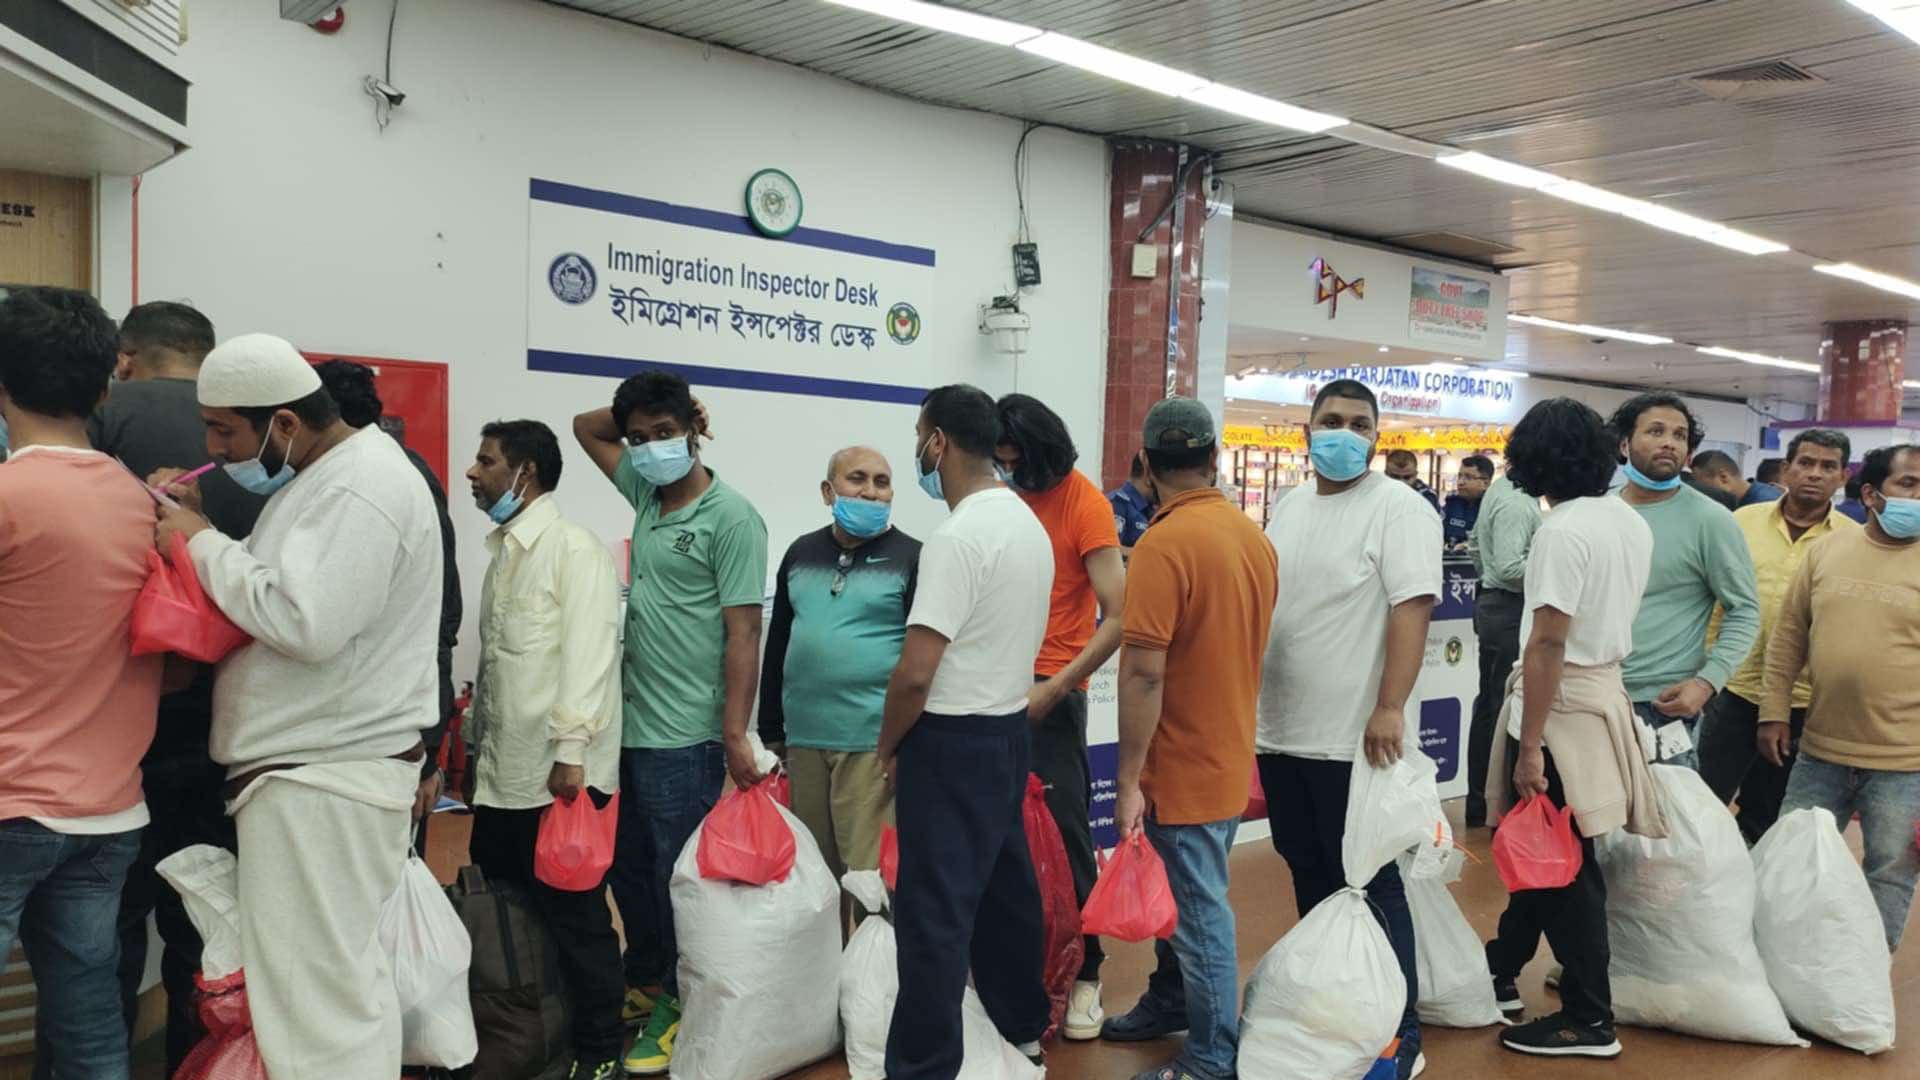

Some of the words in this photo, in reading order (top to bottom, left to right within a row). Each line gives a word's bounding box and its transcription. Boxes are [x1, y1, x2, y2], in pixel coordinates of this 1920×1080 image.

[607, 242, 733, 287] Immigration
[740, 263, 829, 298] Inspector
[835, 277, 879, 308] Desk
[609, 284, 721, 334] ইমিগ্রেশন
[830, 322, 877, 351] ডেস্ক
[1351, 366, 1420, 390] PARJATAN
[1424, 371, 1513, 400] CORPORATION
